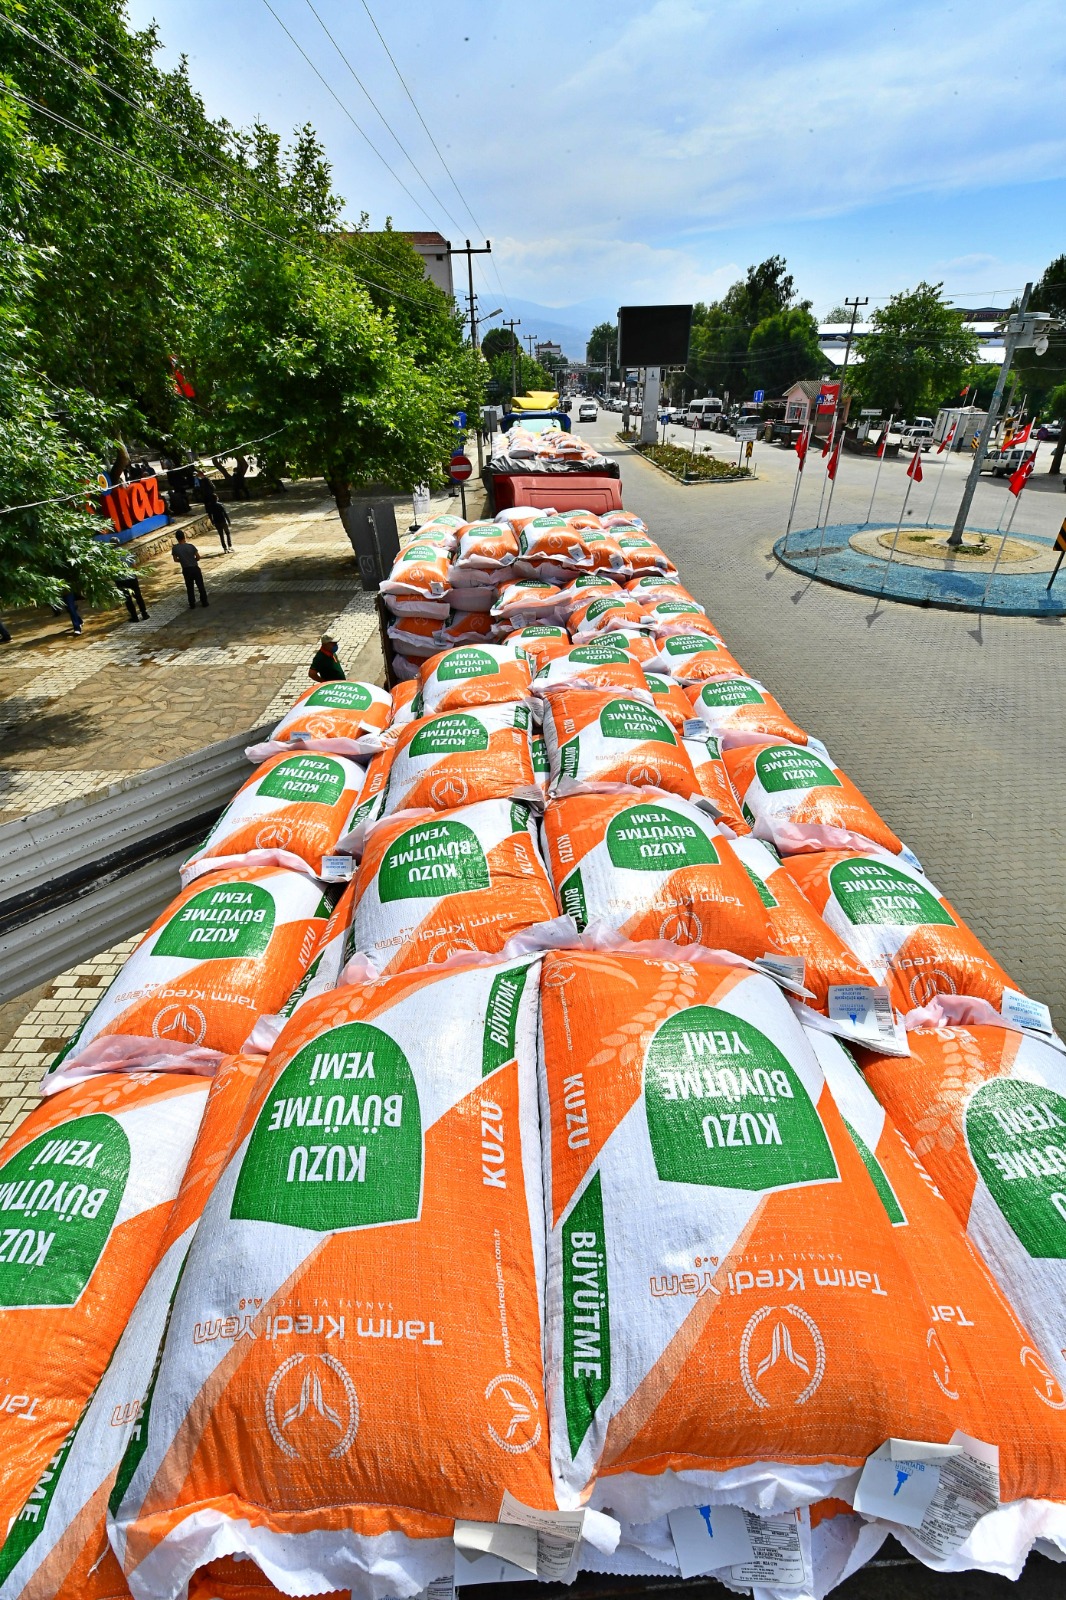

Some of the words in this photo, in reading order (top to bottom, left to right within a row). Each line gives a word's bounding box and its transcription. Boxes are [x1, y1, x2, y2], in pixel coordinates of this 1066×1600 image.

[586, 652, 613, 660] KUZU
[455, 666, 482, 675] KUZU
[324, 696, 353, 705] KUZU
[720, 692, 748, 701] KUZU
[619, 703, 647, 713] YEMİ
[437, 719, 467, 728] YEMİ
[606, 713, 664, 728] BÜYÜTME
[624, 722, 657, 733] KUZU
[431, 737, 466, 747] KUZU
[298, 758, 330, 770] YEMİ
[769, 749, 802, 758] YEMİ
[276, 767, 340, 784] BÜYÜTME
[762, 758, 822, 773] BÜYÜTME
[782, 770, 818, 781] KUZU
[283, 780, 320, 794] KUZU
[630, 812, 672, 826] YEMİ
[409, 826, 451, 848] YEMİ
[615, 825, 697, 842] BÜYÜTME
[389, 840, 473, 869] BÜYÜTME
[513, 842, 536, 876] KUZU
[556, 833, 575, 865] KUZU
[641, 842, 687, 859] KUZU
[408, 863, 457, 884] KUZU
[848, 866, 894, 877] YEMİ
[211, 891, 254, 903] YEMİ
[840, 880, 924, 895] BÜYÜTME
[564, 887, 587, 927] BÜYÜT
[871, 897, 922, 910] KUZU
[179, 908, 267, 926] BÜYÜTME
[188, 927, 241, 943] KUZU
[297, 926, 318, 969] KUZU
[149, 988, 202, 1001] Kredi
[210, 991, 258, 1012] Tarım
[489, 979, 518, 1049] BÜYÜTME
[309, 1050, 376, 1086] YEMİ
[659, 1068, 795, 1104] BÜYÜTME
[267, 1093, 404, 1135] BÜYÜTME
[562, 1072, 592, 1151] KUZU
[701, 1112, 783, 1149] KUZU
[28, 1139, 104, 1171] YEMİ
[480, 1100, 508, 1190] KUZU
[287, 1143, 367, 1184] KUZU
[0, 1179, 110, 1223] BÜYÜTM
[0, 1228, 56, 1266] KUZ
[650, 1271, 722, 1298] Yem
[727, 1267, 806, 1297] Kredi
[814, 1268, 889, 1297] Tarım
[570, 1231, 606, 1381] BÜYÜTME
[931, 1304, 976, 1328] Tar
[193, 1314, 258, 1345] Yem
[264, 1314, 346, 1341] Kredi
[357, 1316, 444, 1347] Tarım
[0, 1392, 41, 1421] Tar
